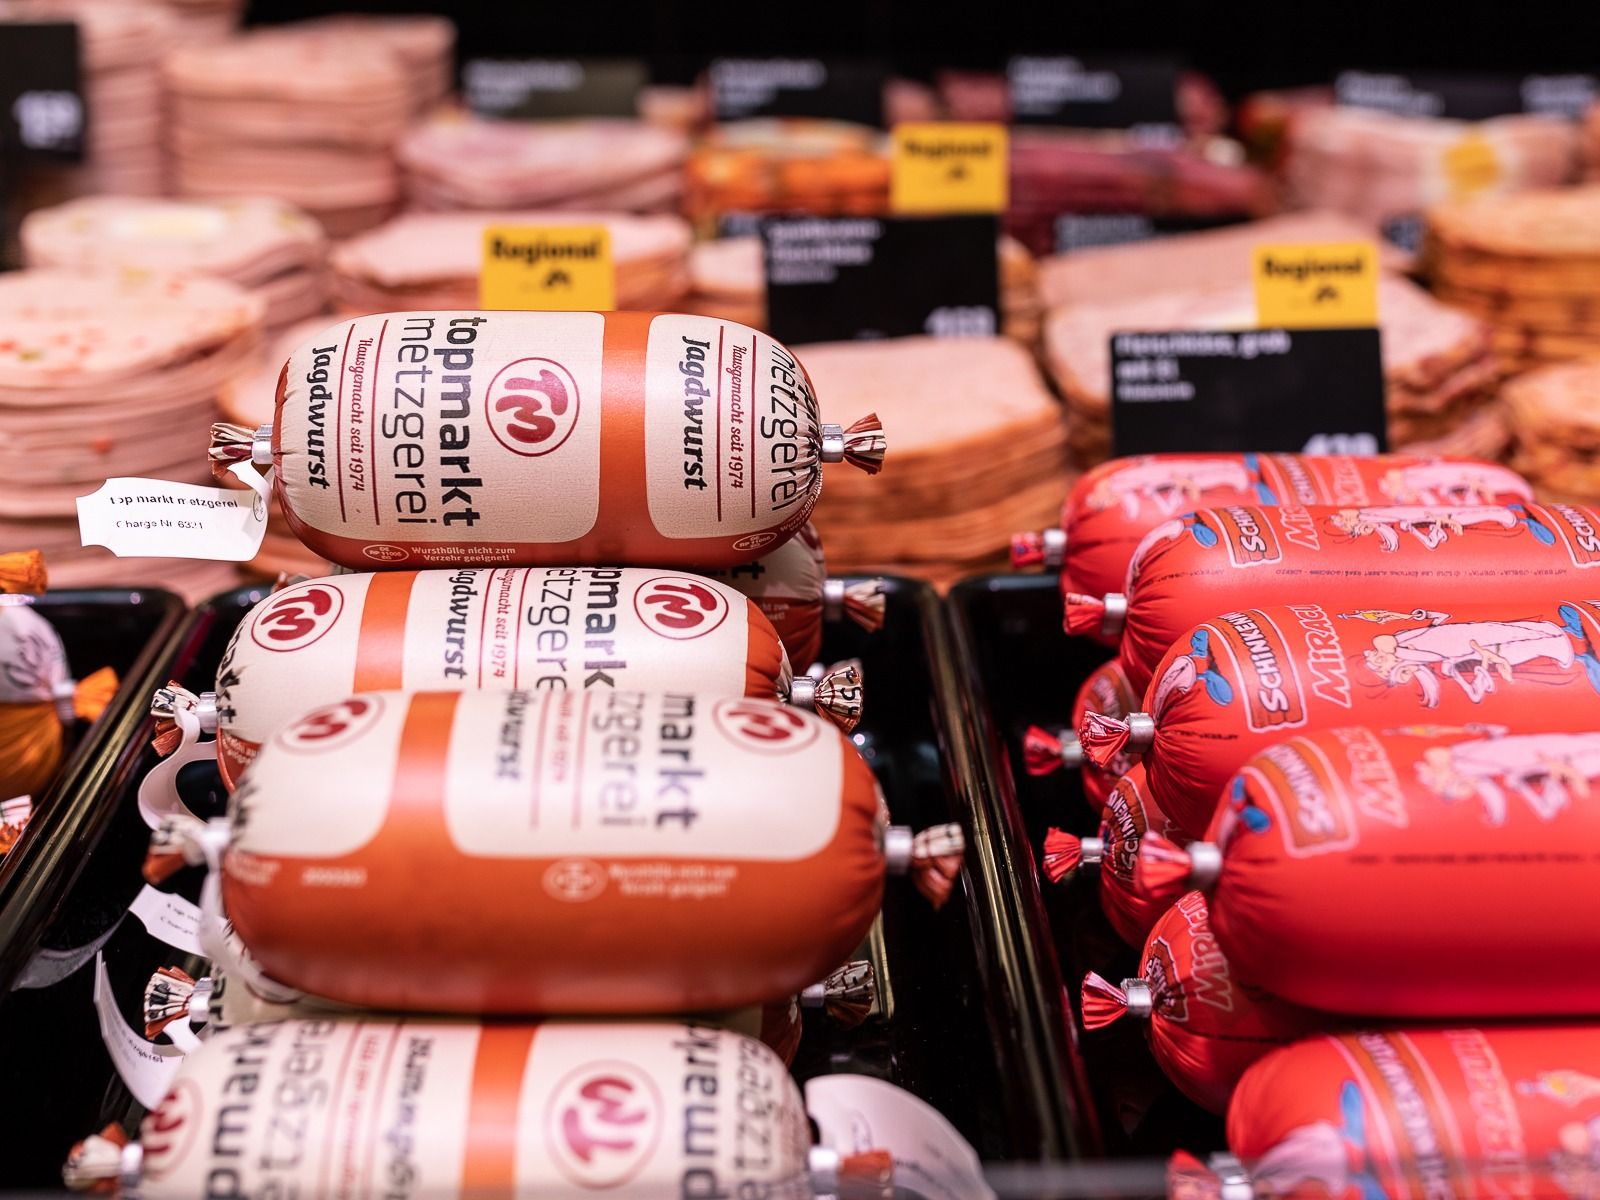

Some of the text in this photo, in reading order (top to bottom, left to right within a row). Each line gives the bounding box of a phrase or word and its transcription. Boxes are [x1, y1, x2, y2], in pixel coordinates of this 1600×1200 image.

[491, 236, 602, 267] Regional
[1264, 257, 1363, 281] Regional
[307, 344, 338, 490] Jagdwurst
[348, 337, 374, 492] Hausgemacht seit 1974
[381, 317, 438, 525] metzgerei
[433, 316, 489, 528] topmarkt
[679, 336, 712, 491] Jagdwurst
[725, 344, 748, 489] Hausgemacht seit 1974
[760, 344, 801, 512] metzgerei
[411, 546, 517, 555] Wursthülle nicht zum
[423, 554, 511, 563] Verzehr geeignet!
[491, 567, 522, 678] ausgemacht seit 1974
[526, 567, 582, 693] etzgere
[581, 567, 629, 690] pmark
